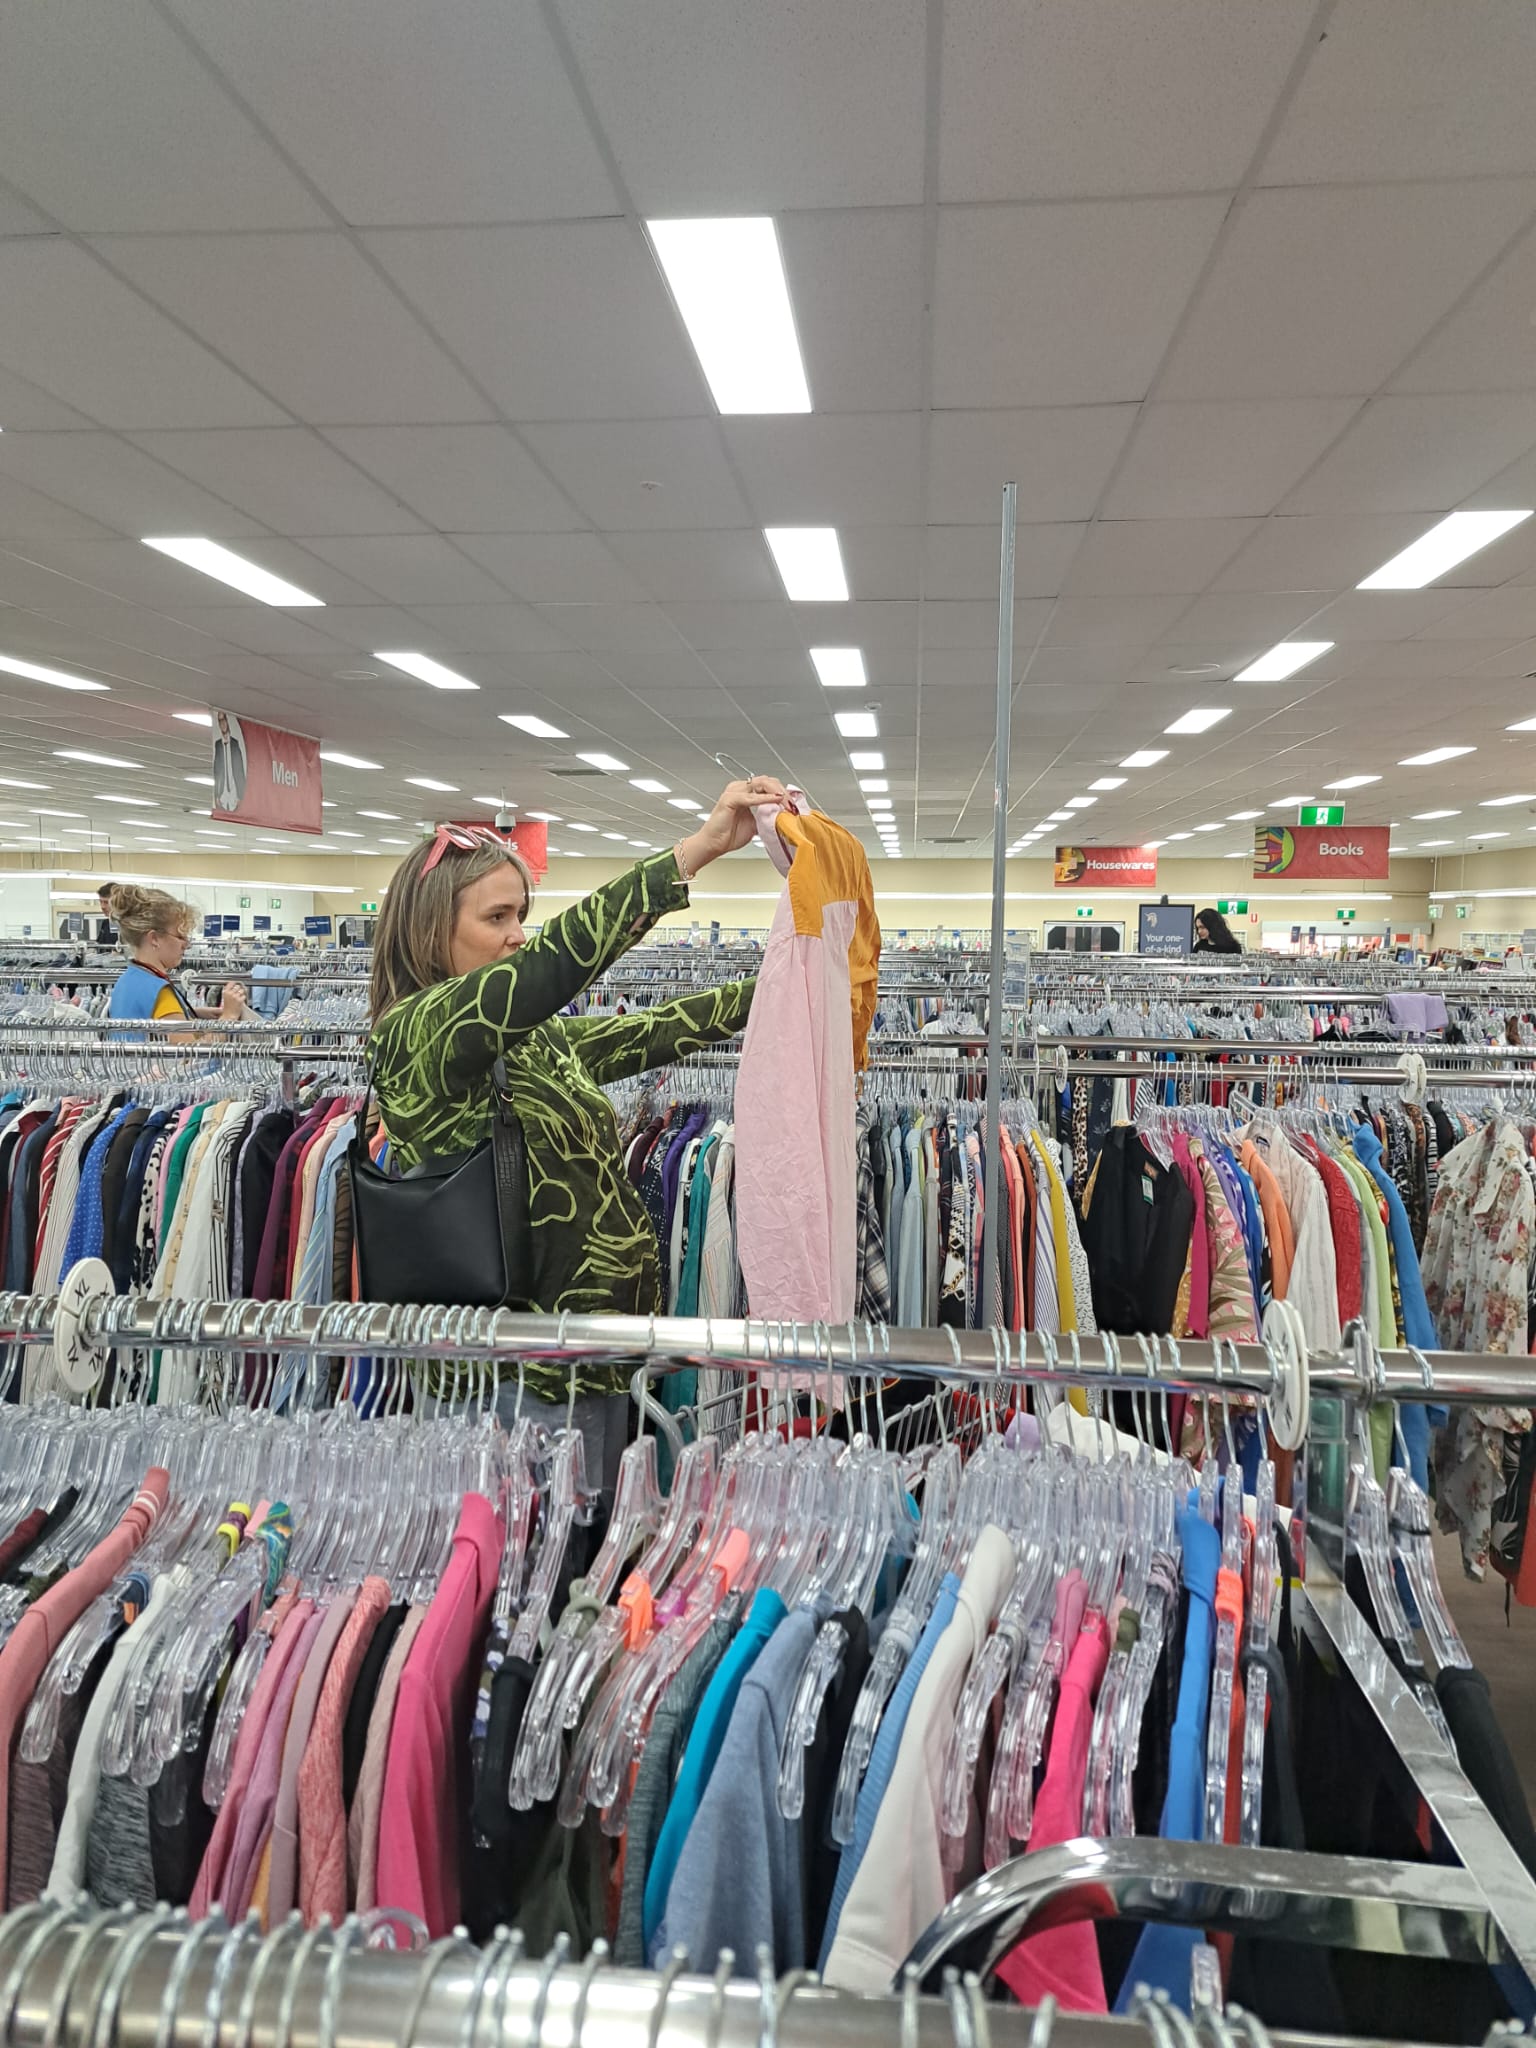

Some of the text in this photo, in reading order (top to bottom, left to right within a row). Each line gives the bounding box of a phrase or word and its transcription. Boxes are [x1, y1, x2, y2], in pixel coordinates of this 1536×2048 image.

[272, 760, 298, 787] Men
[1319, 843, 1364, 856] Books
[1086, 860, 1155, 870] Housewares
[1145, 934, 1164, 942] Your
[1145, 945, 1181, 953] of-a-kind
[75, 1278, 90, 1306] XL
[67, 1335, 79, 1372] XL
